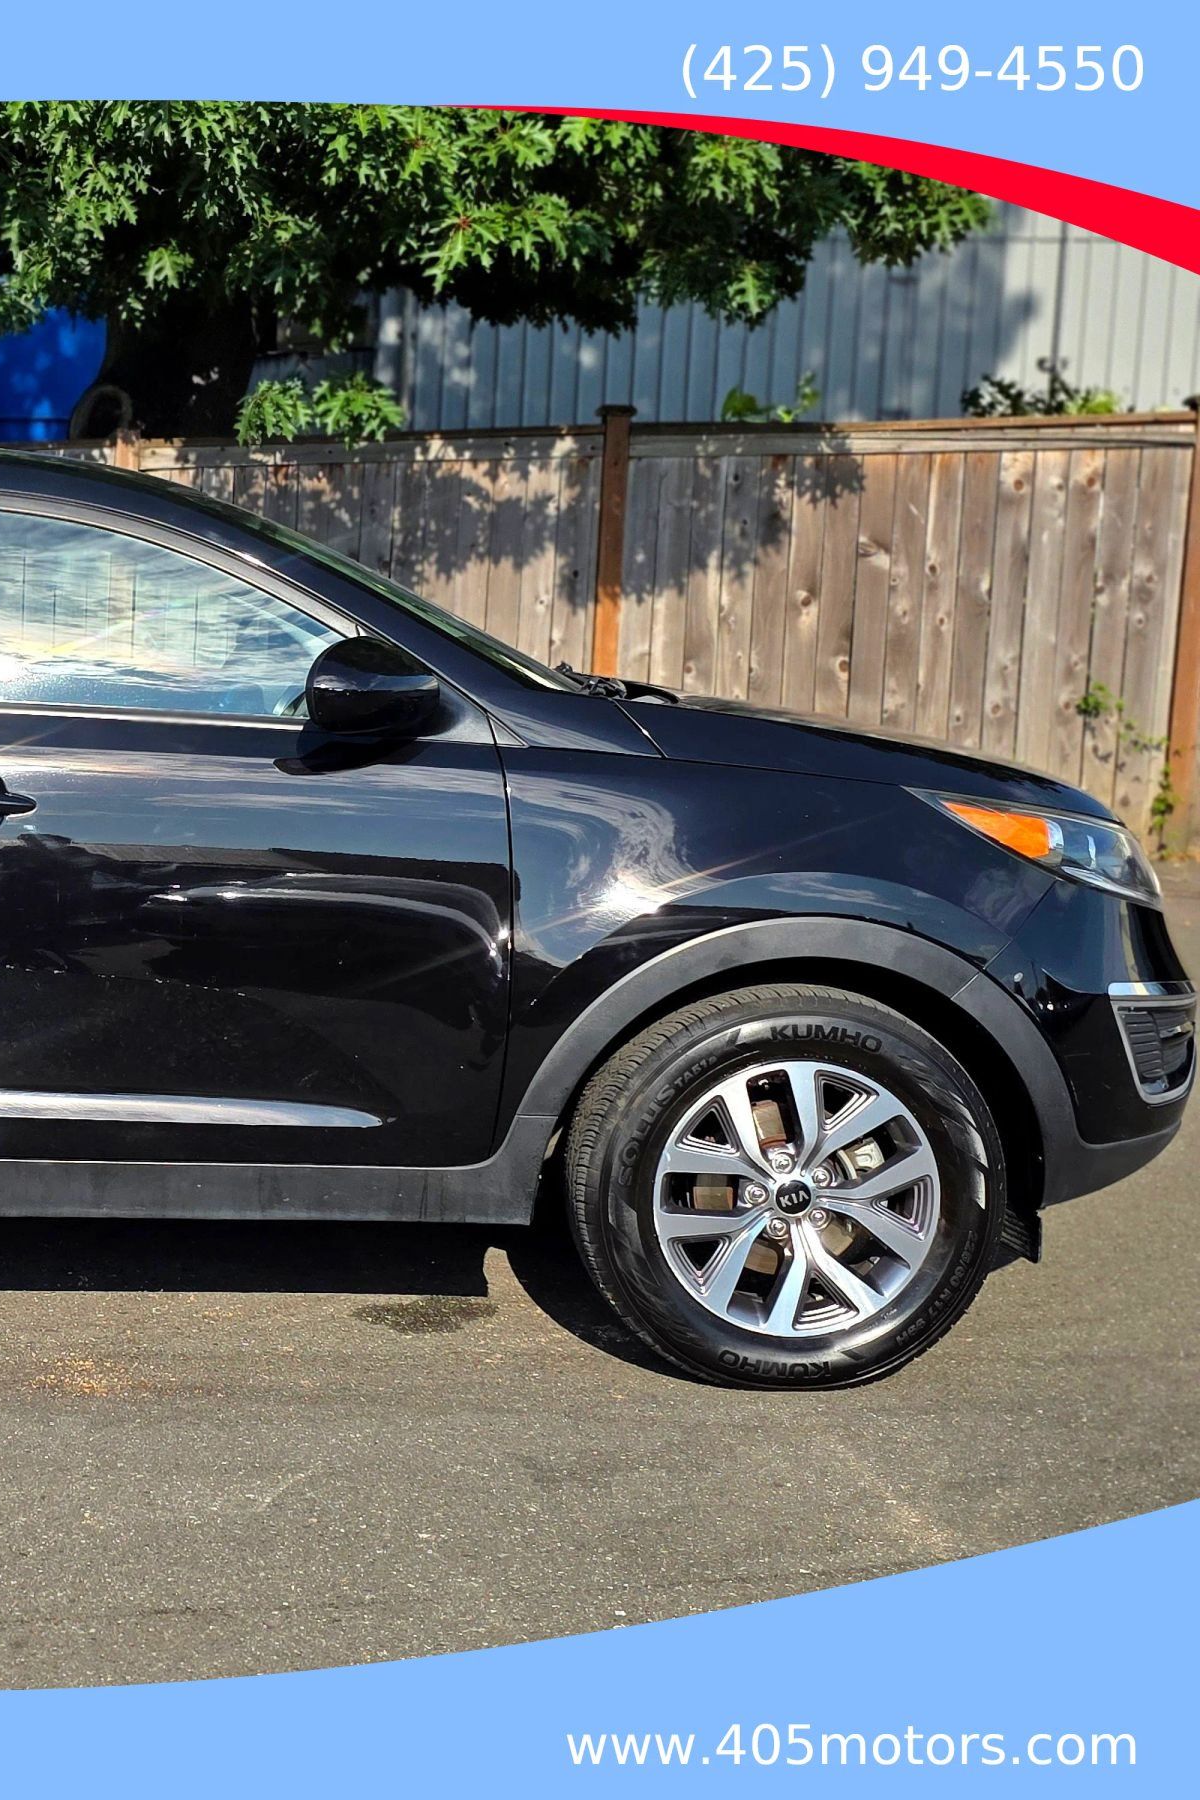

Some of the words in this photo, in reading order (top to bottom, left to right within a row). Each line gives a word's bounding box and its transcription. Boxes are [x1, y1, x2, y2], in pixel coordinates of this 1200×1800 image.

[770, 1024, 883, 1055] KUMHO
[617, 1083, 676, 1187] SOLUS
[779, 1190, 809, 1208] KIA
[717, 1349, 833, 1379] KUMHO
